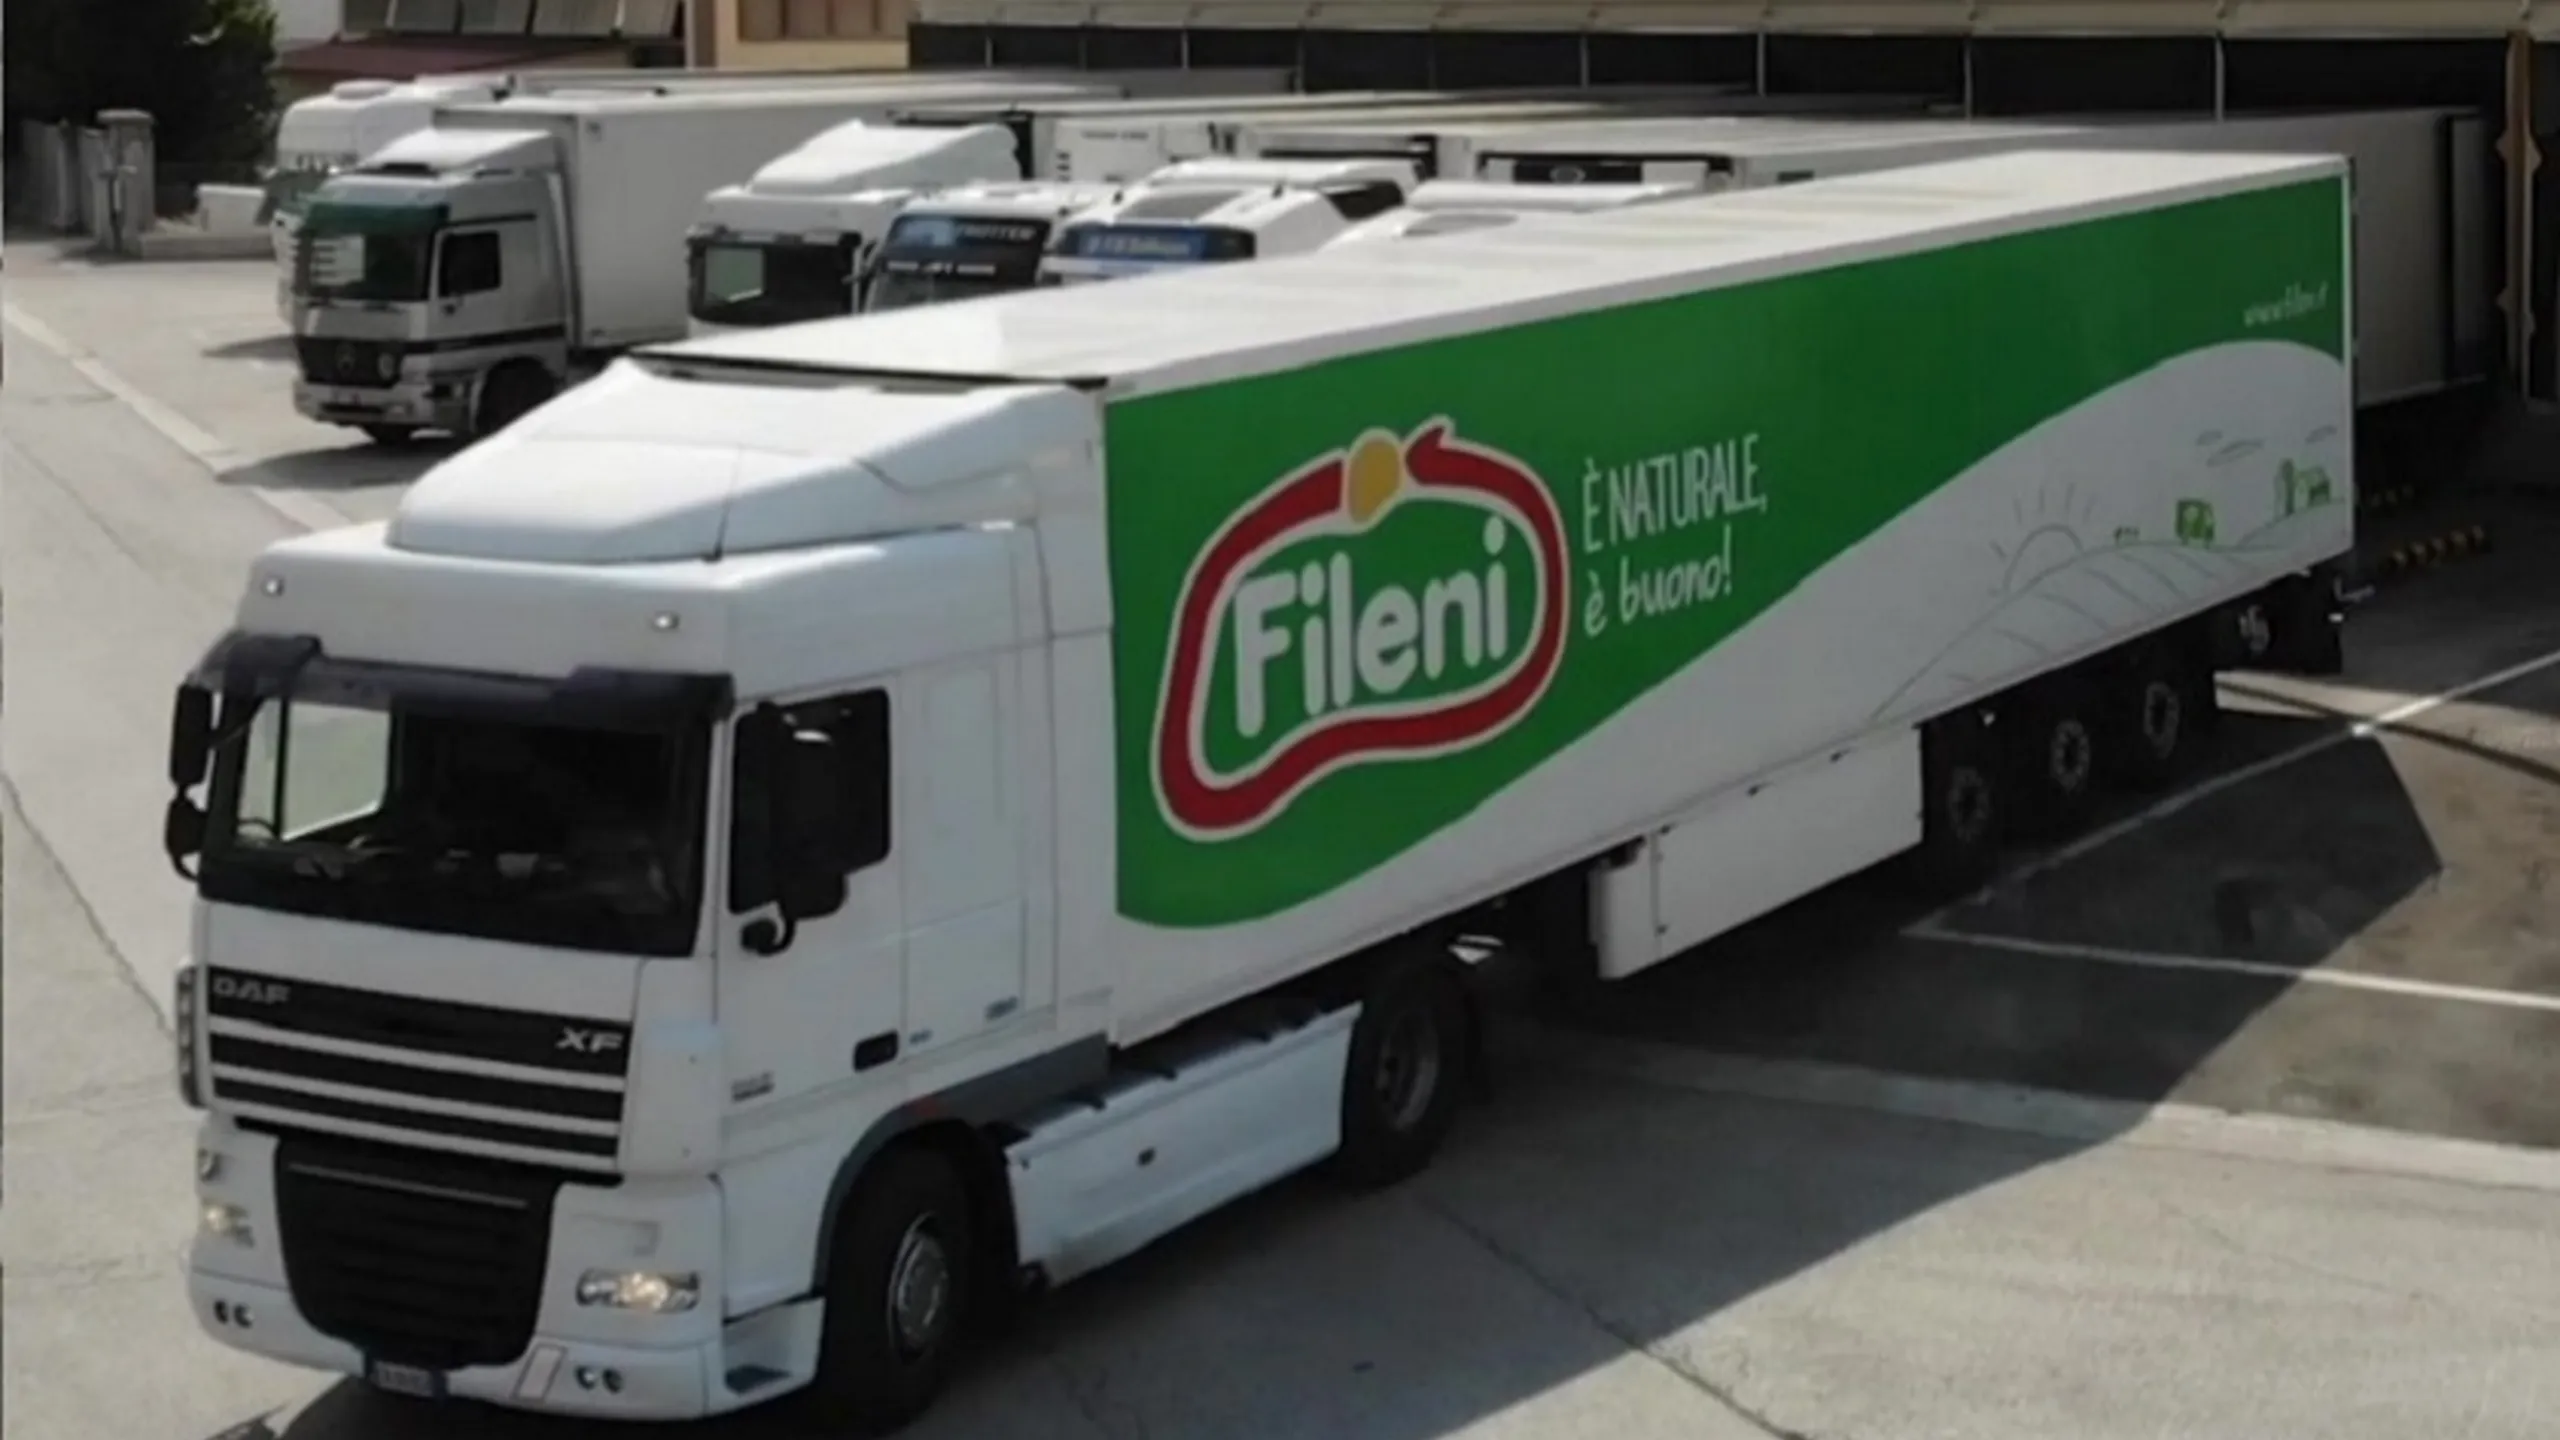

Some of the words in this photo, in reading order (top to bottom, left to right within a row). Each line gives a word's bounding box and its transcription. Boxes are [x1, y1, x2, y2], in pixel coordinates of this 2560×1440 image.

[1582, 456, 1604, 555] È
[1608, 432, 1768, 546] NATURALE,
[1233, 514, 1509, 739] Fileni
[1583, 568, 1608, 639] è
[1619, 521, 1733, 625] buono!
[555, 1026, 624, 1053] XF
